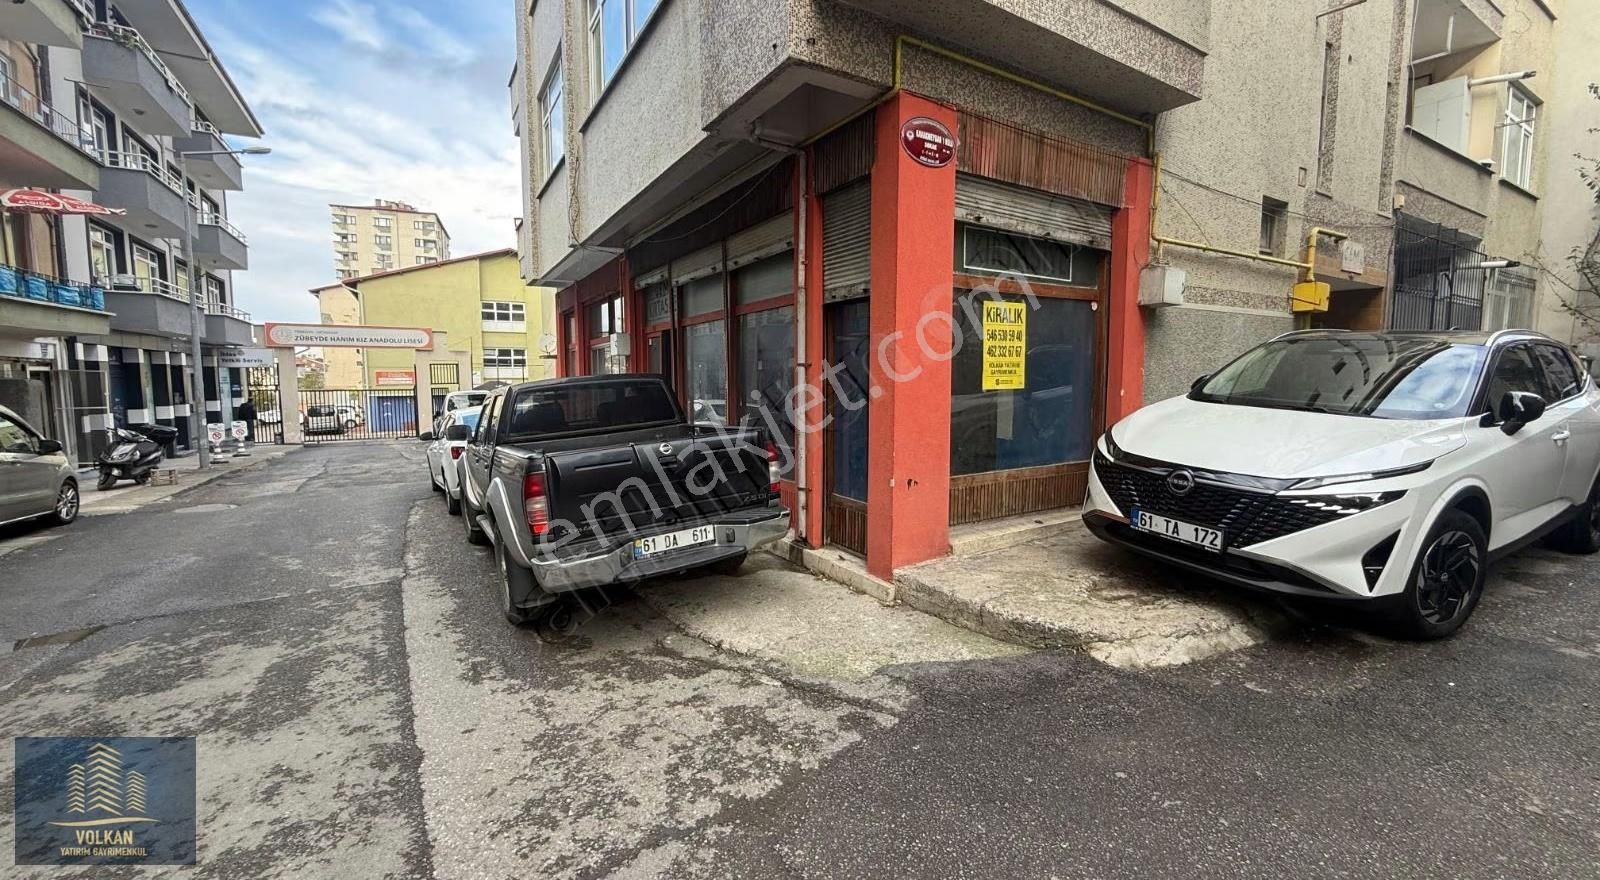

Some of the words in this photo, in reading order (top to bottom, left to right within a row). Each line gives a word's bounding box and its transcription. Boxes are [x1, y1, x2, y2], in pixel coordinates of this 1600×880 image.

[997, 345, 1008, 358] 332
[643, 537, 657, 553] 61
[664, 533, 679, 549] DA
[692, 526, 709, 543] 611
[1139, 512, 1154, 529] 61
[1163, 519, 1180, 537] TA
[1193, 526, 1219, 547] 172
